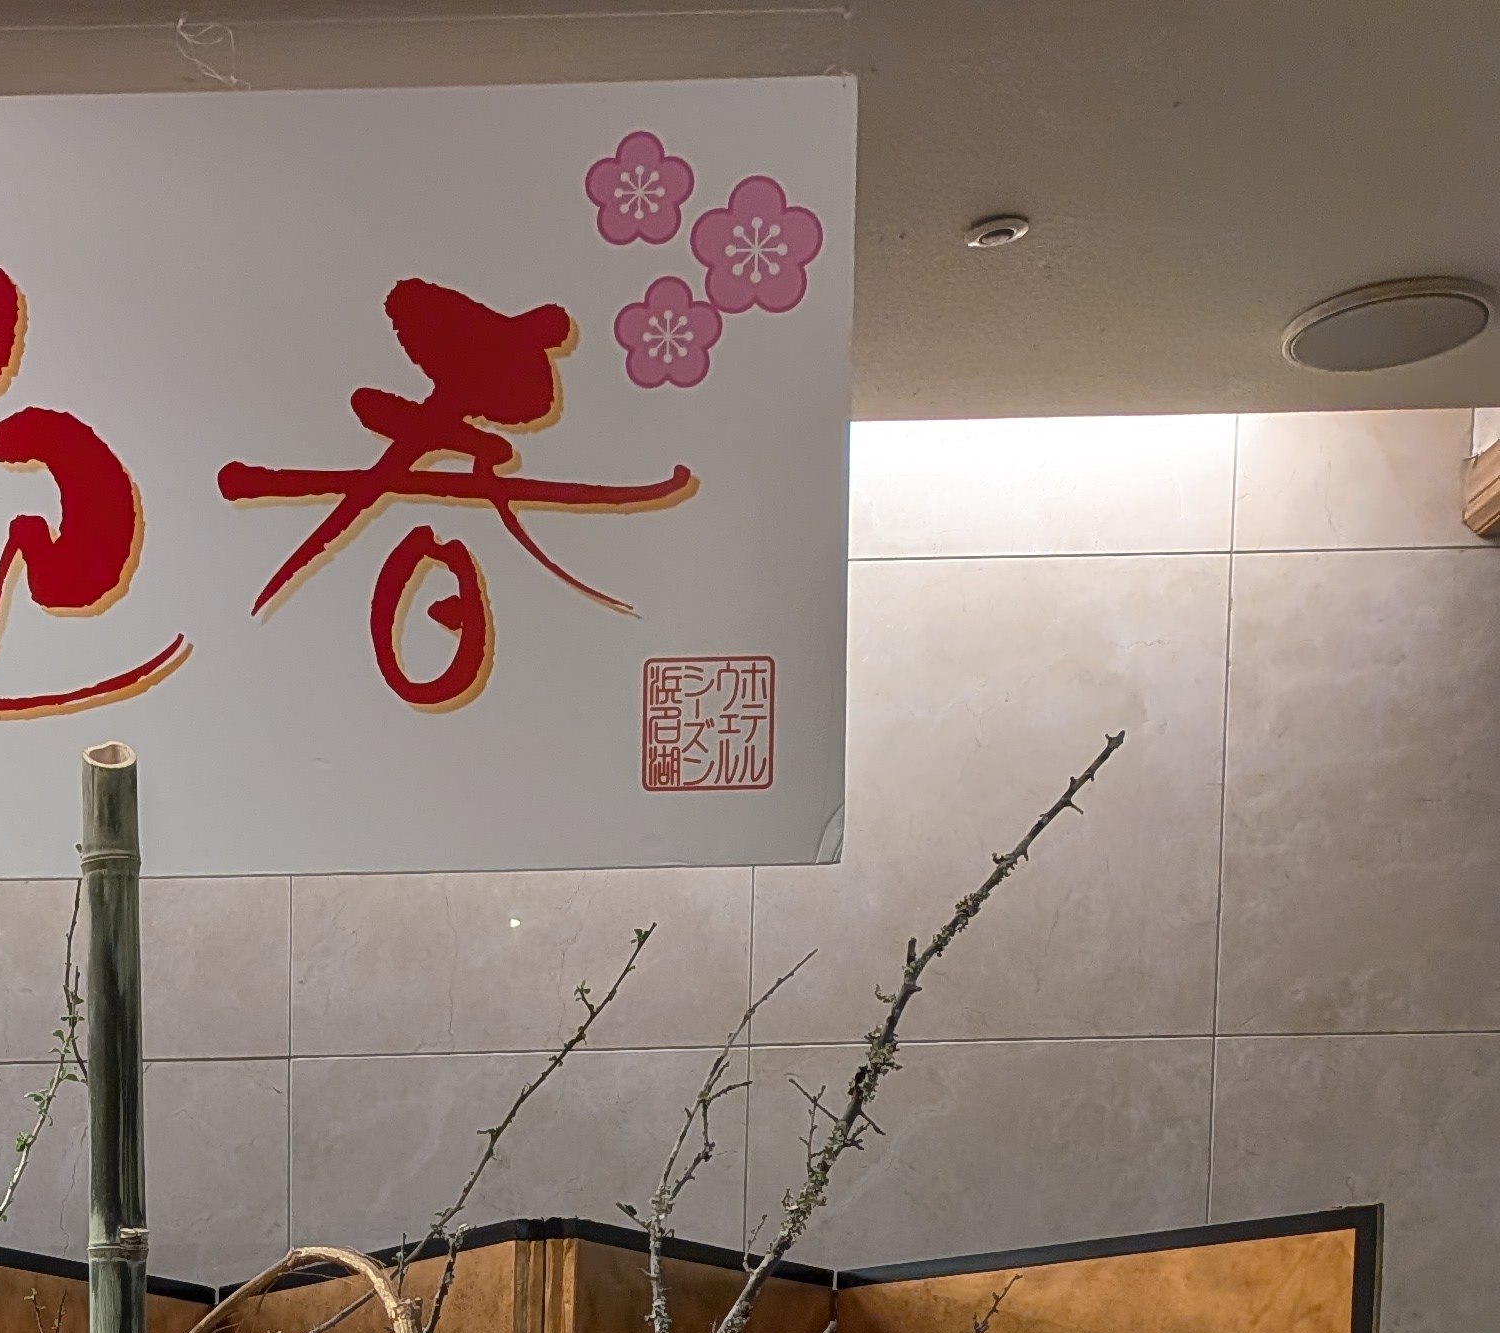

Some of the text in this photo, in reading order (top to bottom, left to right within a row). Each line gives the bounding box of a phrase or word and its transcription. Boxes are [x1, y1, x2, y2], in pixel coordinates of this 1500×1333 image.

[648, 665, 683, 787] 浜名湖
[682, 665, 715, 786] シーズン
[739, 661, 768, 783] ホテル
